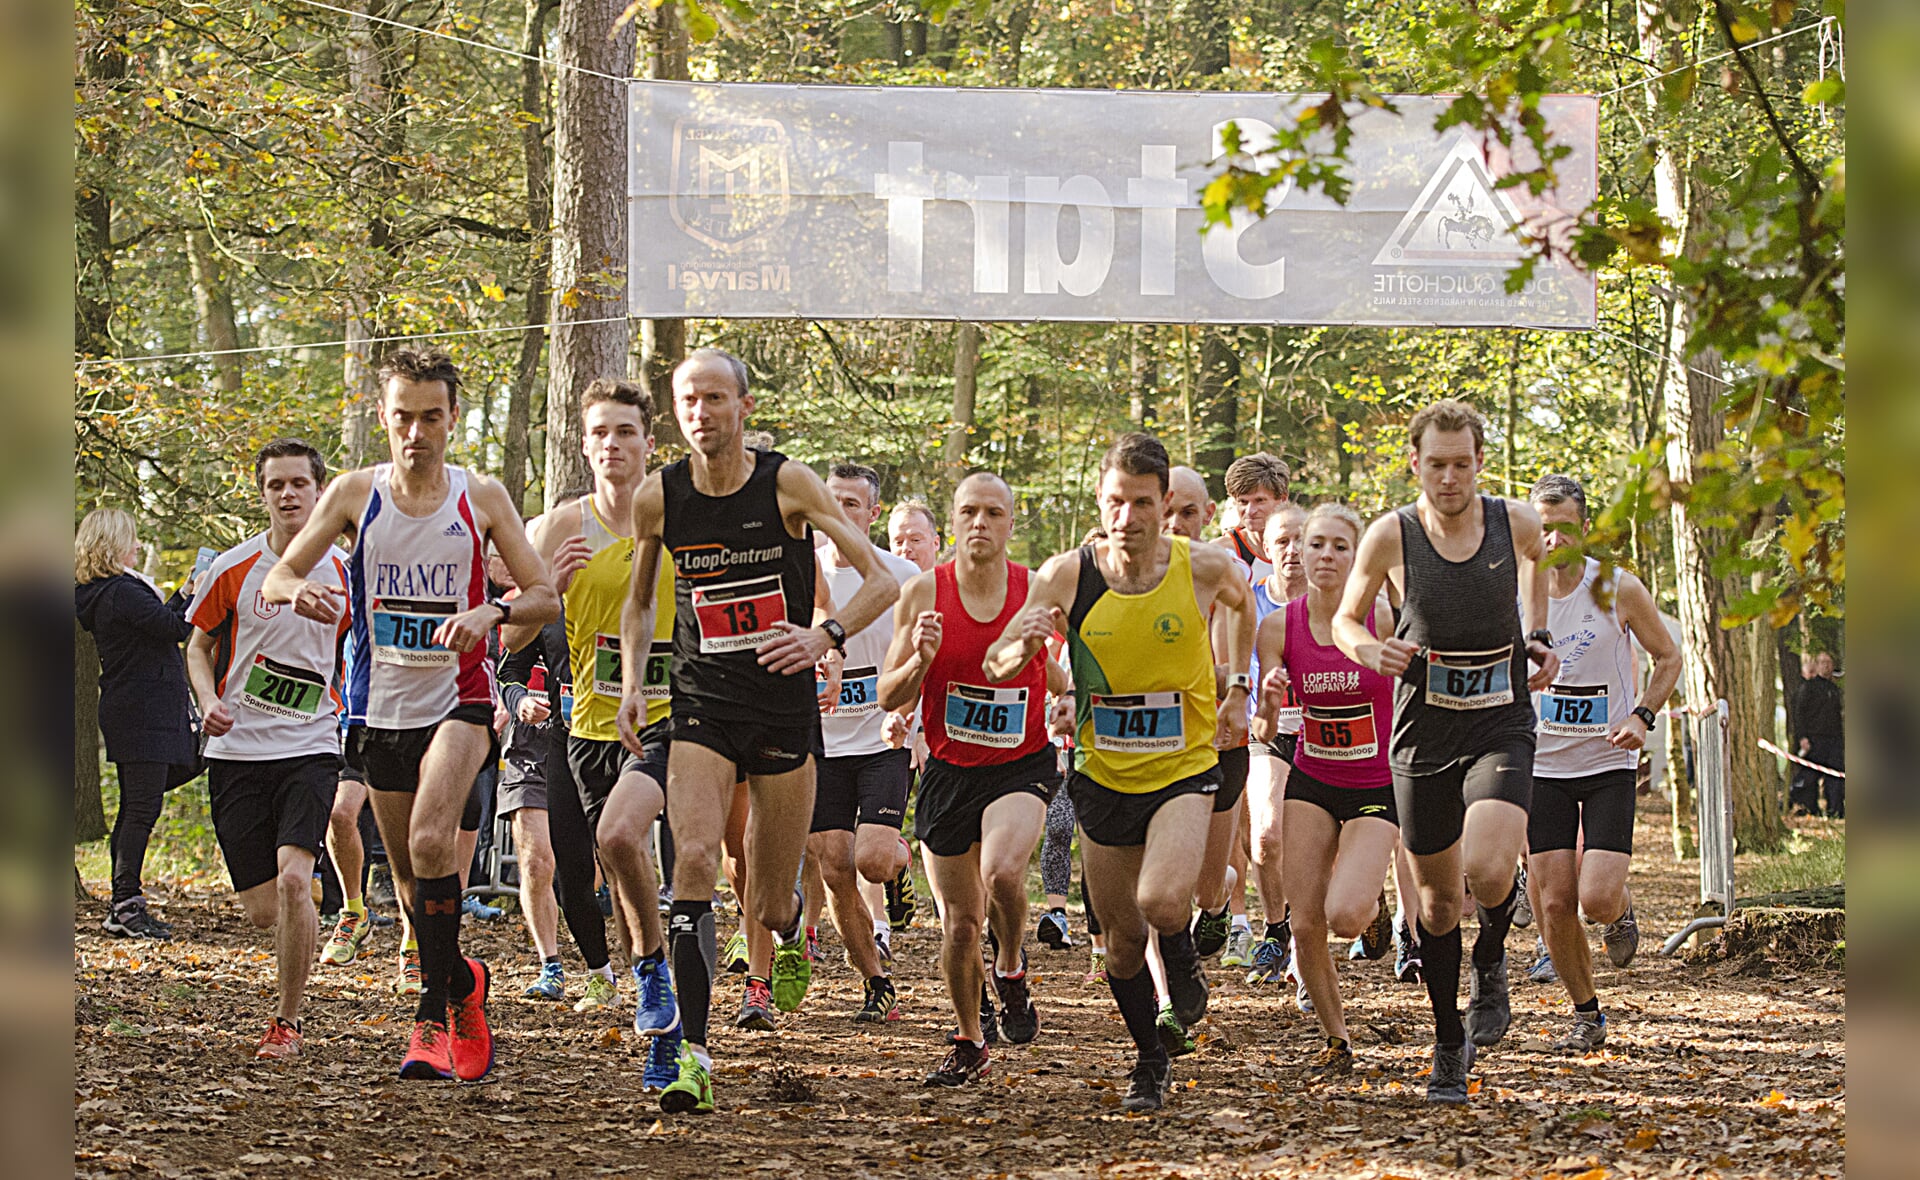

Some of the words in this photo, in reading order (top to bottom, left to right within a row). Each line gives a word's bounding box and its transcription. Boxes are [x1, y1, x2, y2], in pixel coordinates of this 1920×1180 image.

[684, 545, 783, 571] LoopCentrum
[376, 564, 458, 596] FRANCE
[723, 601, 759, 634] 13
[390, 616, 439, 649] 750
[609, 653, 665, 685] 26
[1302, 671, 1345, 684] LOPERS
[1447, 666, 1495, 697] 627
[259, 675, 309, 709] 207
[840, 681, 867, 704] 53
[1303, 683, 1346, 694] COMPANY
[1431, 694, 1508, 707] Sparrenbosloop
[244, 694, 312, 721] Sparrenbosloop
[963, 700, 1008, 732] 746
[1552, 698, 1593, 723] 752
[948, 725, 1019, 744] Sparrenbosloop
[1113, 710, 1159, 737] 747
[1320, 721, 1352, 746] 65
[1100, 737, 1179, 749] Sparrenbosloop
[1308, 744, 1374, 757] Sparrenbosloop
